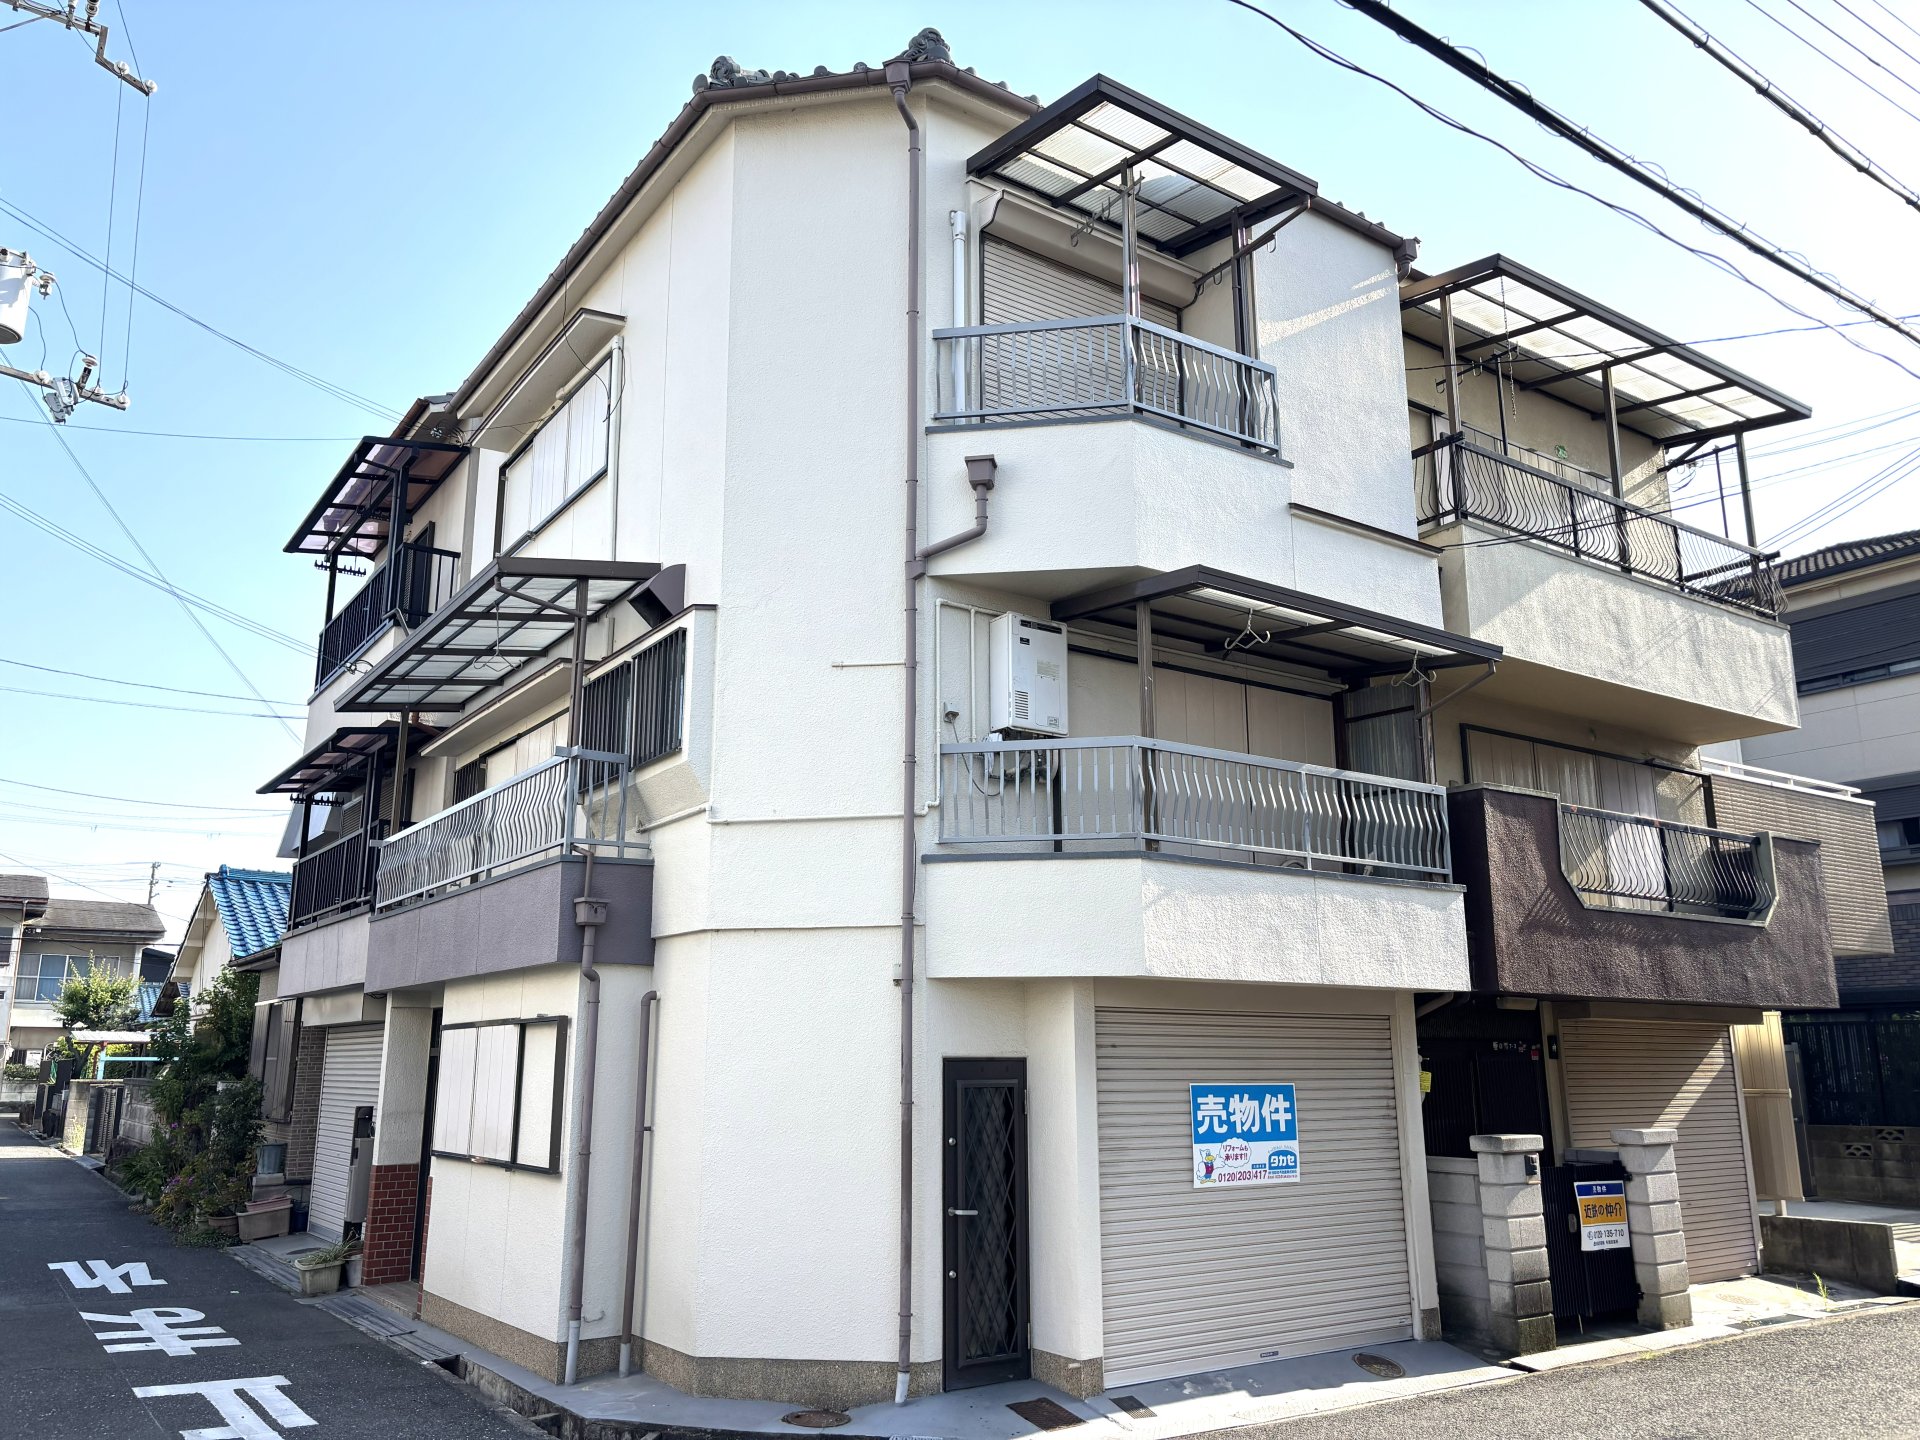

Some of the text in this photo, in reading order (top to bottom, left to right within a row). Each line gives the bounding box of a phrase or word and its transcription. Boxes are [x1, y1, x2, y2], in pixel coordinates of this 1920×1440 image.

[1197, 1094, 1292, 1135] 売物件
[1222, 1144, 1248, 1152] リフォームも
[1270, 1154, 1295, 1167] タカセ
[1218, 1169, 1268, 1182] 0120(203)417
